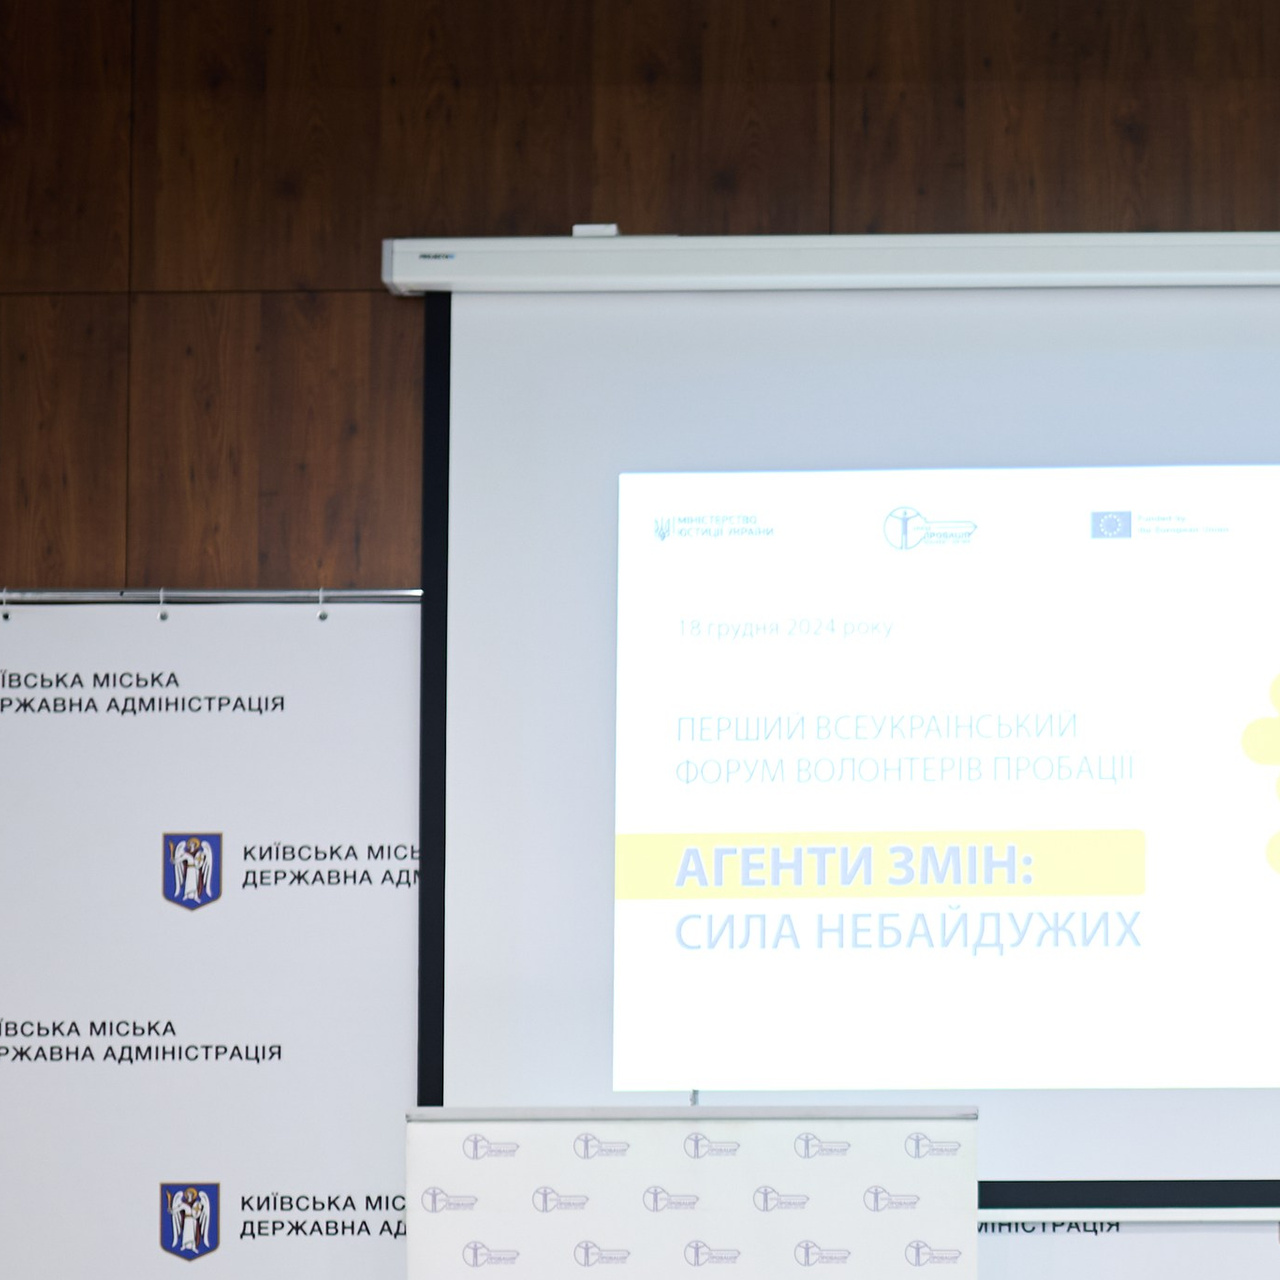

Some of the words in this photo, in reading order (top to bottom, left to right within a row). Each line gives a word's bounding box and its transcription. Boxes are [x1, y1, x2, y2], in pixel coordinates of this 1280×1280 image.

[679, 618, 701, 638] 18
[707, 621, 780, 640] грудня
[787, 617, 837, 637] 2024
[842, 620, 895, 640] року
[92, 671, 180, 689] МІСЬКА
[0, 697, 99, 714] РЖАВНА
[106, 695, 285, 716] АДМІНІСТРАЦІЯ
[677, 712, 806, 743] ПЕРШИЙ
[676, 756, 785, 785] ФОРУМ
[796, 755, 983, 784] ВОЛОНТЕРІВ
[243, 842, 358, 862] КИЇВСЬКА
[675, 845, 874, 888] АГЕНТИ
[887, 843, 1035, 886] ЗМІН:
[241, 869, 373, 890] ДЕРЖАВНА
[675, 912, 801, 951] СИЛА
[816, 904, 1143, 957] НЕБАЙДУЖИХ
[89, 1020, 177, 1037] МІСЬКА
[102, 1044, 282, 1065] АДМІНІСТРАЦІЯ
[241, 1192, 357, 1212] КИЇВСЬКА
[239, 1219, 371, 1240] ДЕРЖАВНА
